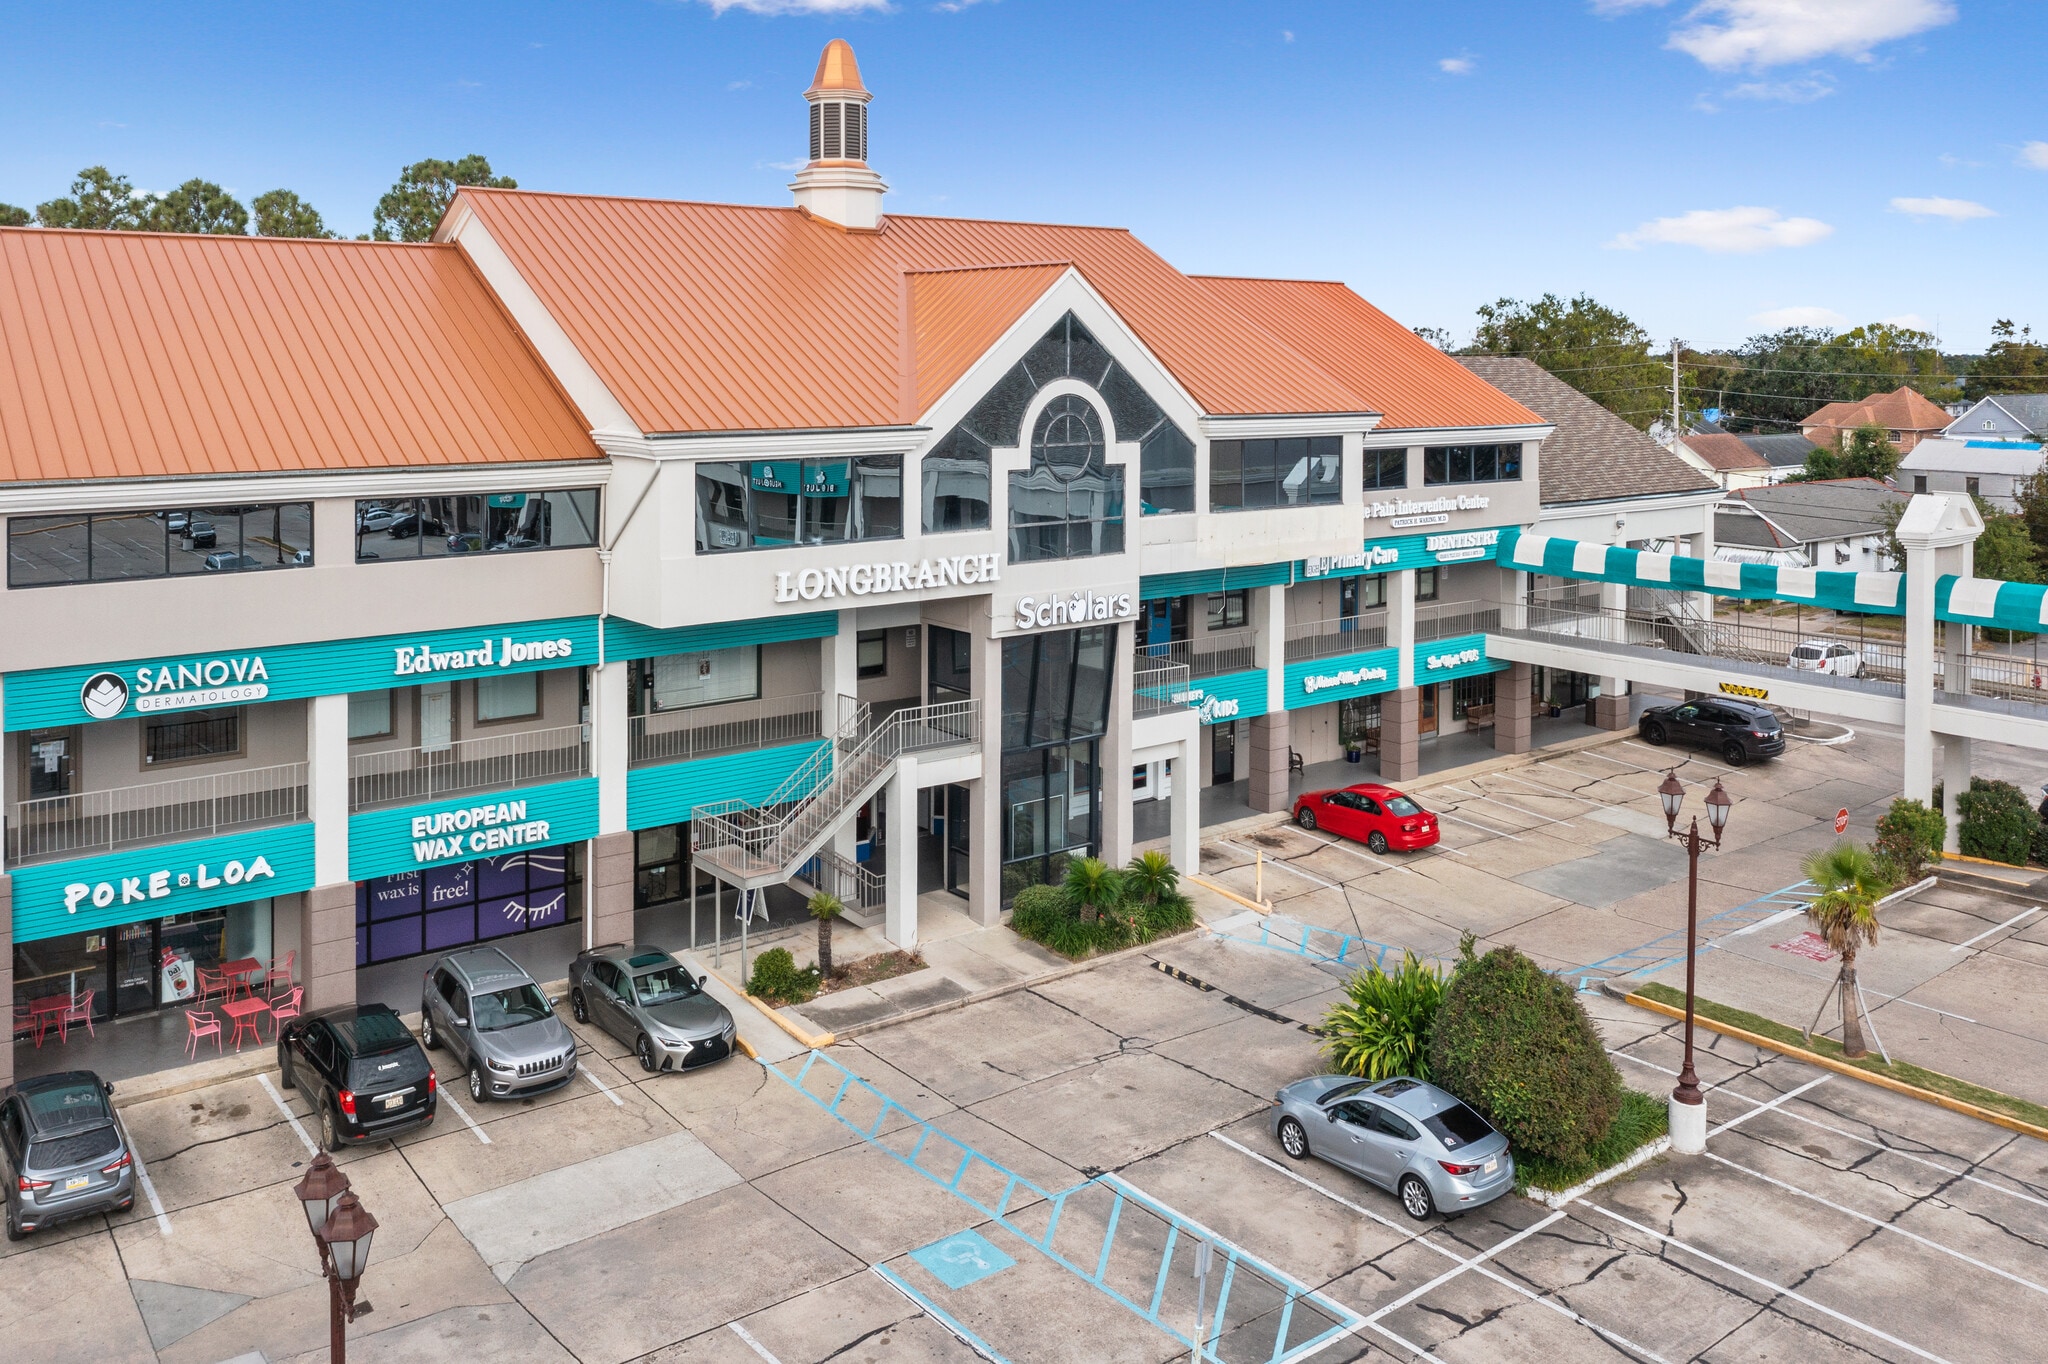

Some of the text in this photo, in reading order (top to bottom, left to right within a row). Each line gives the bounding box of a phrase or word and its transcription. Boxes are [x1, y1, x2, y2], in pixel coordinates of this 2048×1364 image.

[1372, 501, 1396, 518] Pain
[1395, 496, 1457, 515] Intervention
[1457, 494, 1490, 510] Center
[1426, 530, 1499, 552] DENTISTRY
[1331, 551, 1372, 570] Primary
[1372, 546, 1398, 564] Care
[775, 552, 1001, 603] LONGBRANCH
[1016, 590, 1131, 630] Scholars
[394, 637, 573, 675] Edward Jones
[135, 656, 269, 694] SANOVA
[142, 687, 263, 709] DERMATOLOGY
[1213, 698, 1239, 718] KIDS
[412, 800, 526, 838] EUROPEAN
[1836, 815, 1848, 827] STOP
[412, 820, 550, 863] WAX CENTER
[64, 856, 275, 914] POKE LOA
[377, 880, 469, 902] wax is free!
